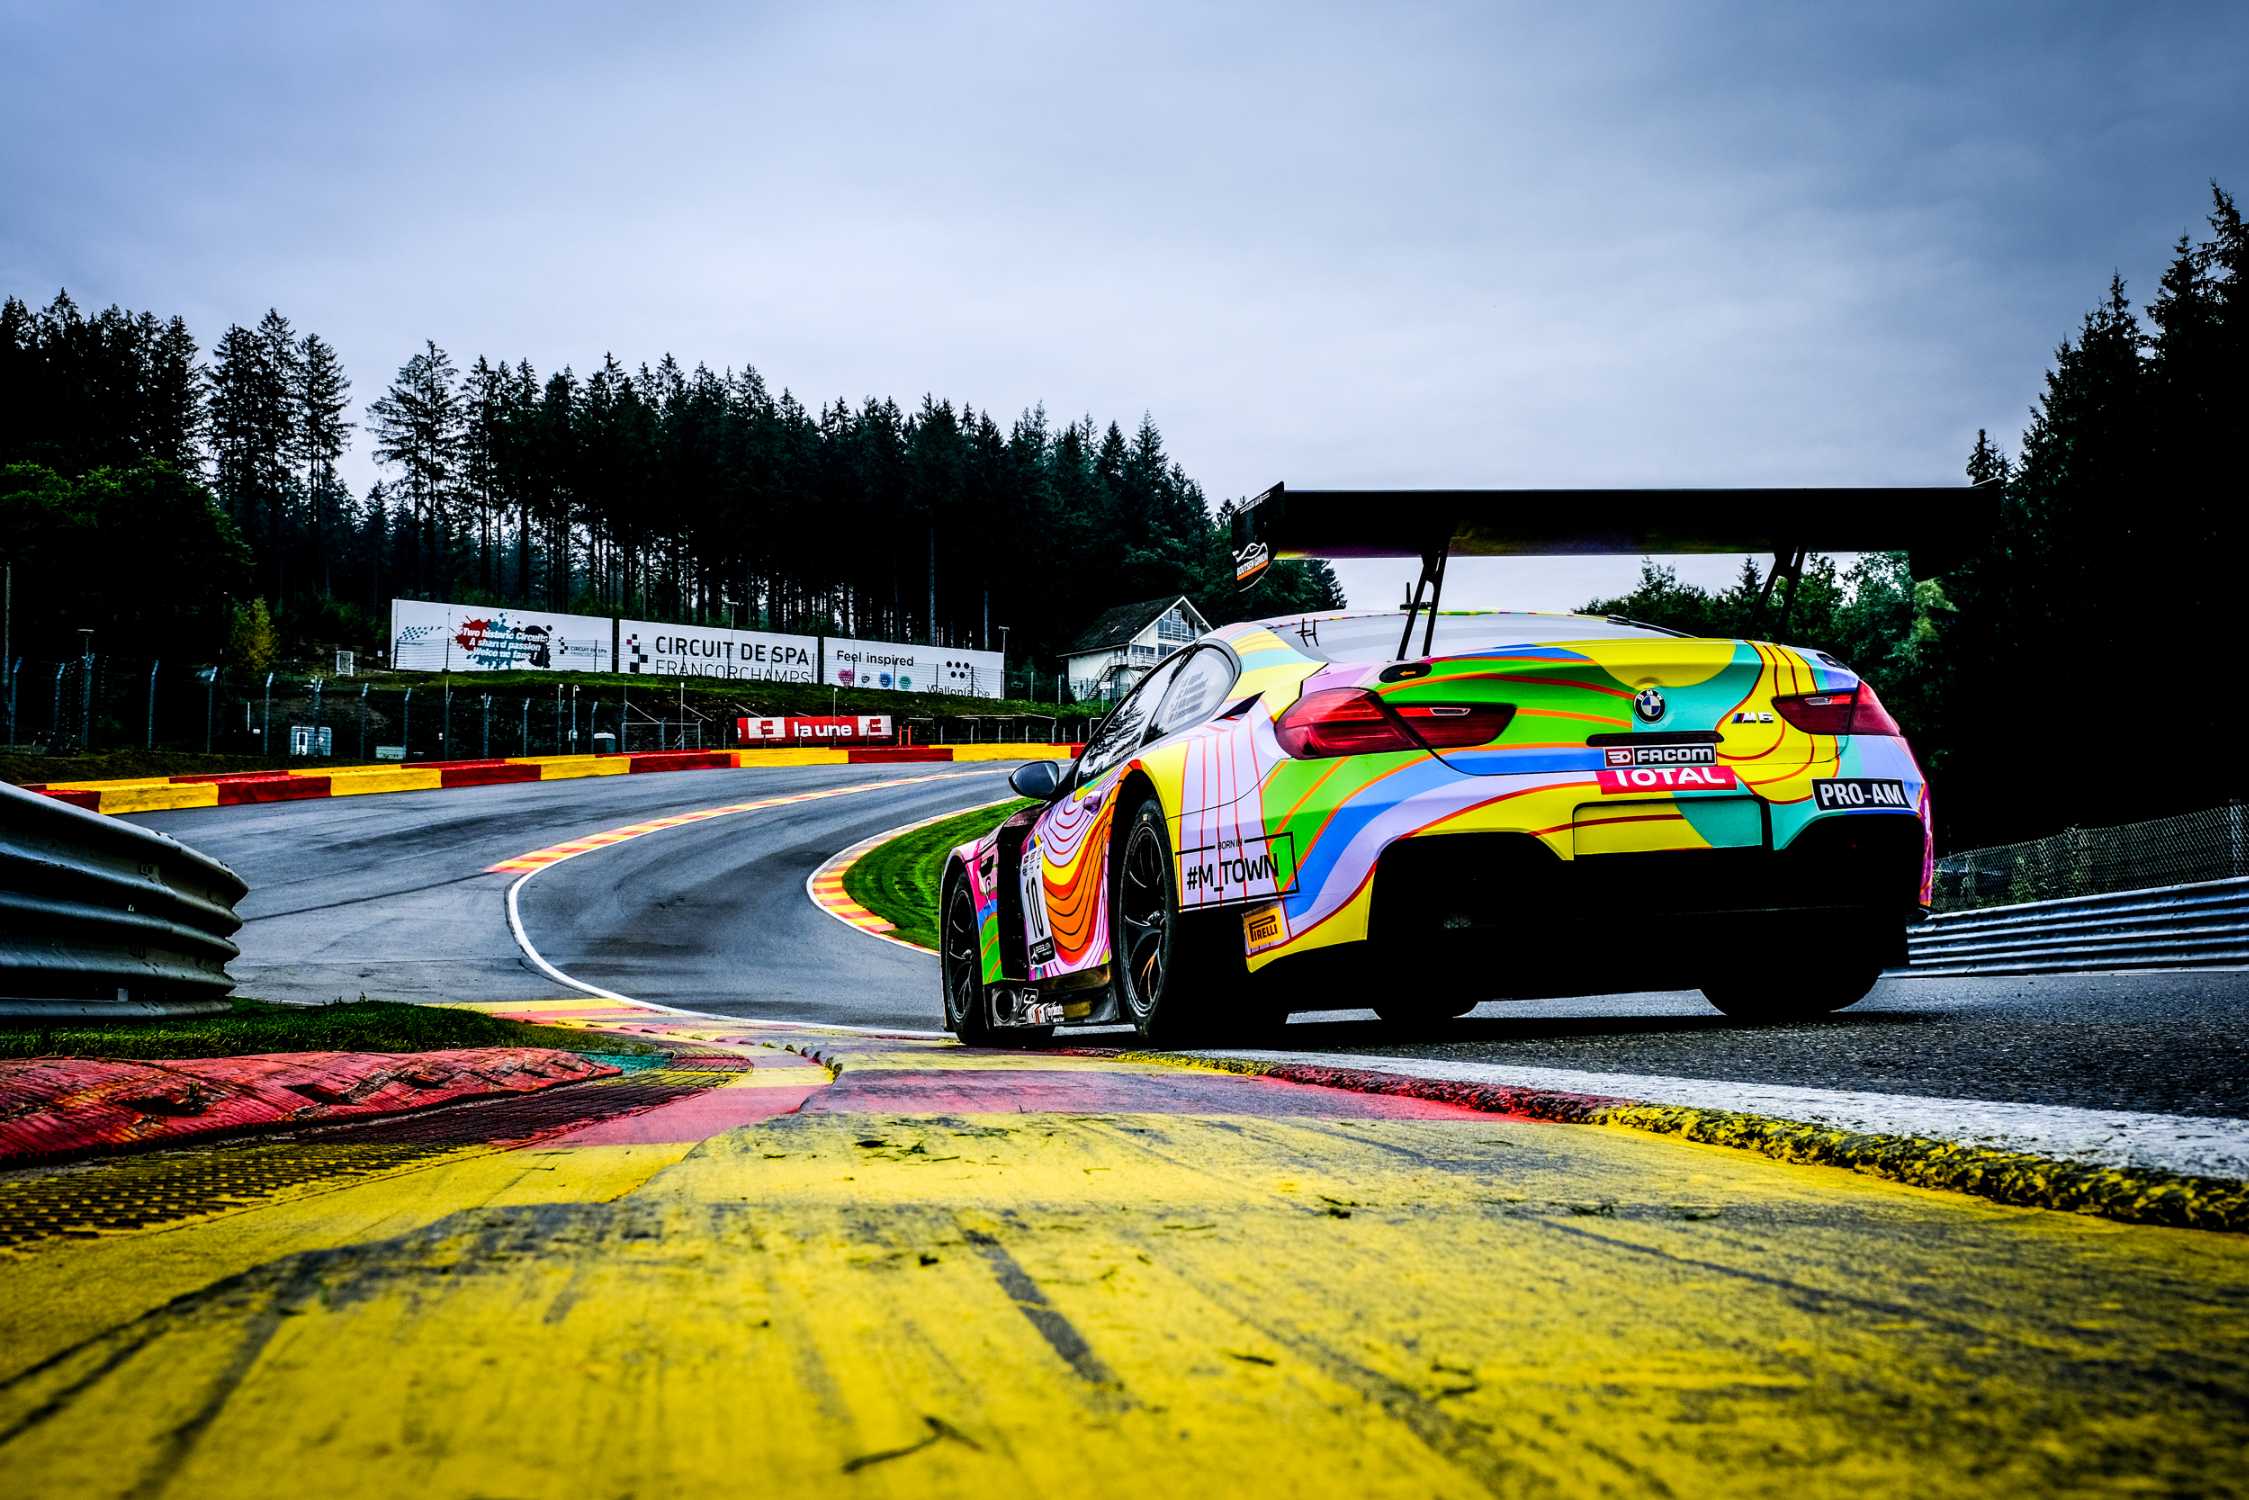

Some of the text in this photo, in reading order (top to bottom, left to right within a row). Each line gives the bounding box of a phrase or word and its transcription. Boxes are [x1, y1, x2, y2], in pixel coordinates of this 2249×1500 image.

[463, 627, 480, 637] Two
[481, 629, 514, 640] historic
[469, 637, 476, 646] A
[508, 641, 541, 652] passion
[656, 635, 809, 666] CIRCUIT DE SPA
[837, 650, 914, 667] Feel inspired
[656, 659, 810, 684] FRANCORCHAMPS
[1742, 711, 1774, 723] M6
[793, 721, 852, 737] la une
[1637, 748, 1713, 763] FACOM
[1615, 767, 1726, 787] TOTAL
[1820, 783, 1906, 807] PRO-AM
[1217, 839, 1235, 850] BORN
[1187, 852, 1279, 892] #M_TOWN
[1248, 914, 1279, 942] PIRELLI
